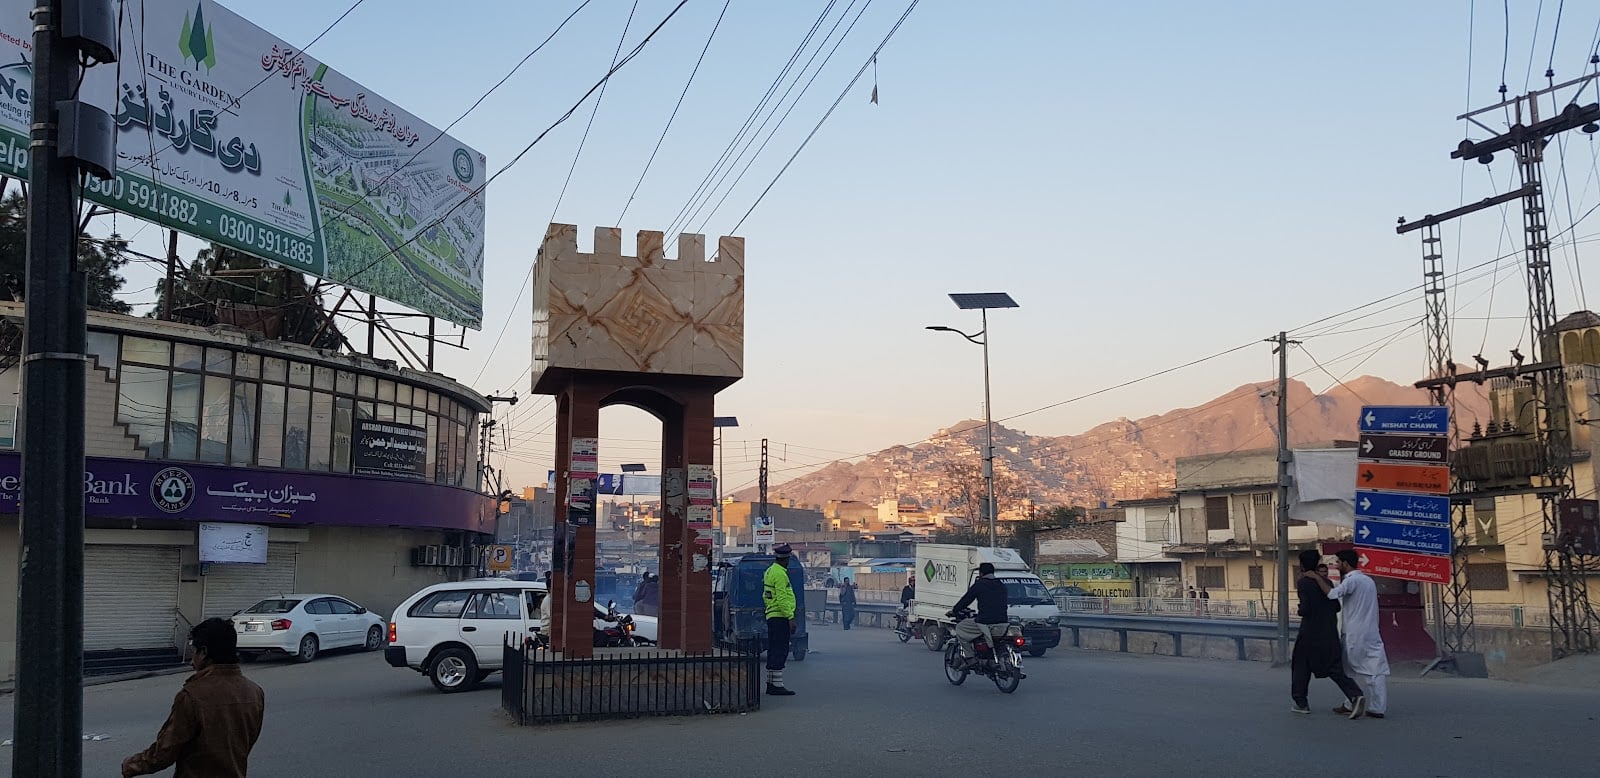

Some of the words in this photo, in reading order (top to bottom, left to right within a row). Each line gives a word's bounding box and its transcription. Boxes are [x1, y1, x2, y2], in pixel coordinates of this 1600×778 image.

[147, 52, 177, 79] THE
[180, 69, 241, 110] GARDENS
[169, 81, 197, 99] LUXURY
[198, 95, 221, 109] LIVING
[217, 136, 260, 172] دی
[127, 180, 198, 226] 5911882
[219, 213, 255, 245] 0300
[257, 233, 314, 265] 5911883
[1389, 449, 1413, 458] GRASSY
[1414, 451, 1441, 459] GROUND
[155, 470, 193, 489] MEEZAN
[89, 496, 110, 504] Bank
[206, 481, 268, 503] بینک
[268, 483, 317, 503] میزان
[160, 500, 186, 510] BANK
[1414, 512, 1442, 520] COLLEGE
[1376, 536, 1392, 544] SAIDU
[1393, 539, 1417, 547] MEDICAL
[1417, 541, 1443, 549] COLLEGE
[936, 563, 957, 583] PREMIER
